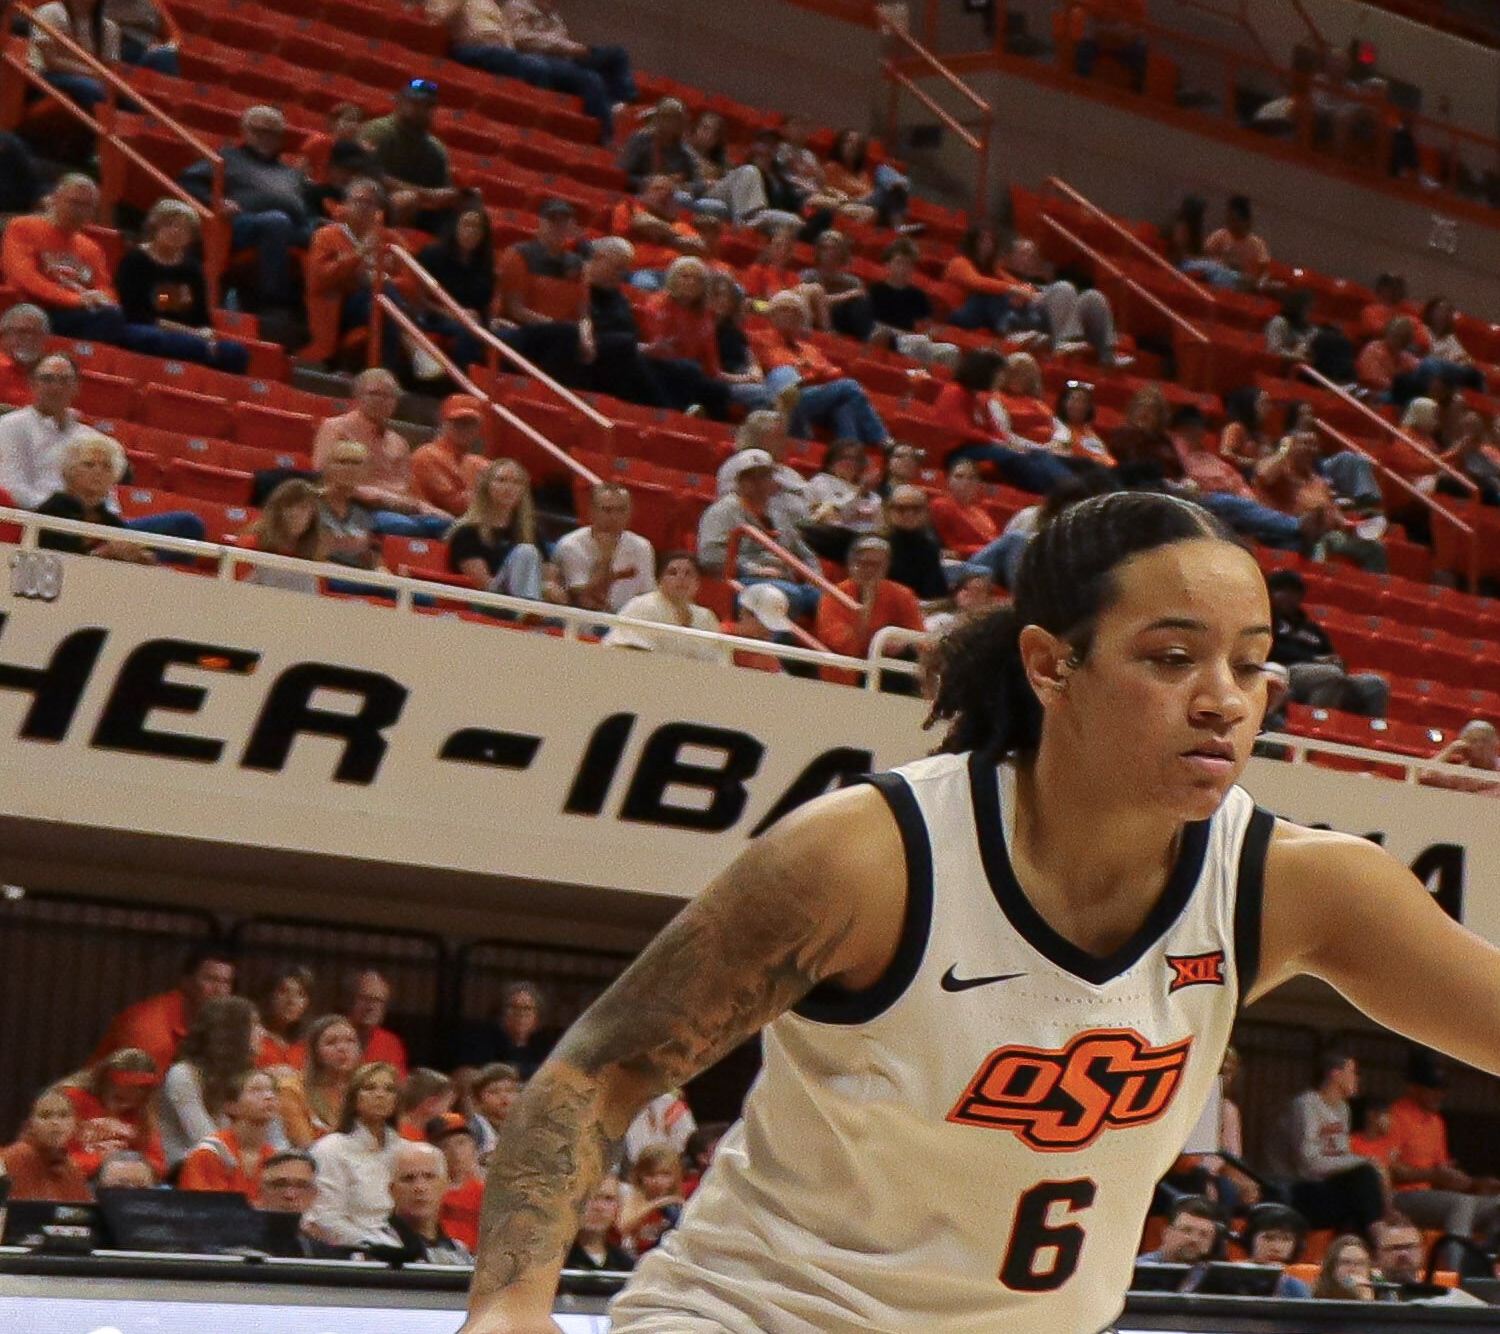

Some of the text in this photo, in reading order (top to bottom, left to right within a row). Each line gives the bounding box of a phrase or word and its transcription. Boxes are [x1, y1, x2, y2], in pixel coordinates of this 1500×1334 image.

[1166, 950, 1226, 993] XII
[945, 1027, 1194, 1152] OSU
[999, 1177, 1096, 1293] 6
